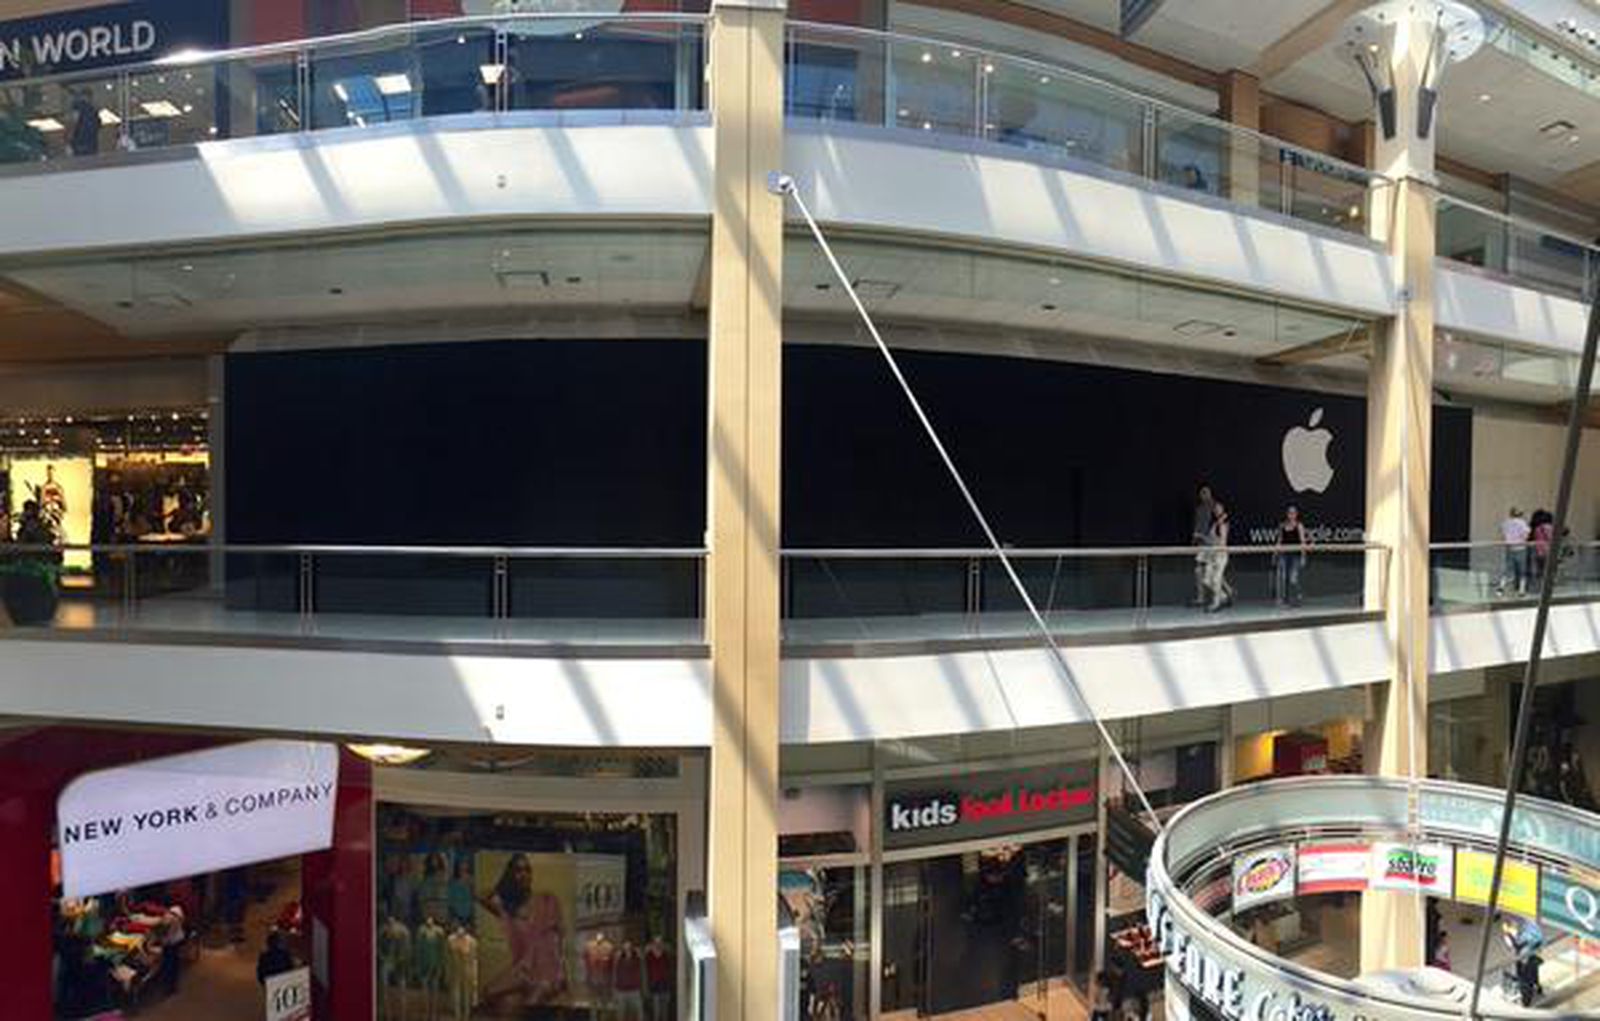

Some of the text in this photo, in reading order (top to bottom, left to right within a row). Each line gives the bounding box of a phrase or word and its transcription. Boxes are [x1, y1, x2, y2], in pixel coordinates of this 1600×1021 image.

[32, 20, 156, 64] WORLD
[64, 782, 333, 844] NEW YORK & COMPANY
[891, 800, 957, 831] kids
